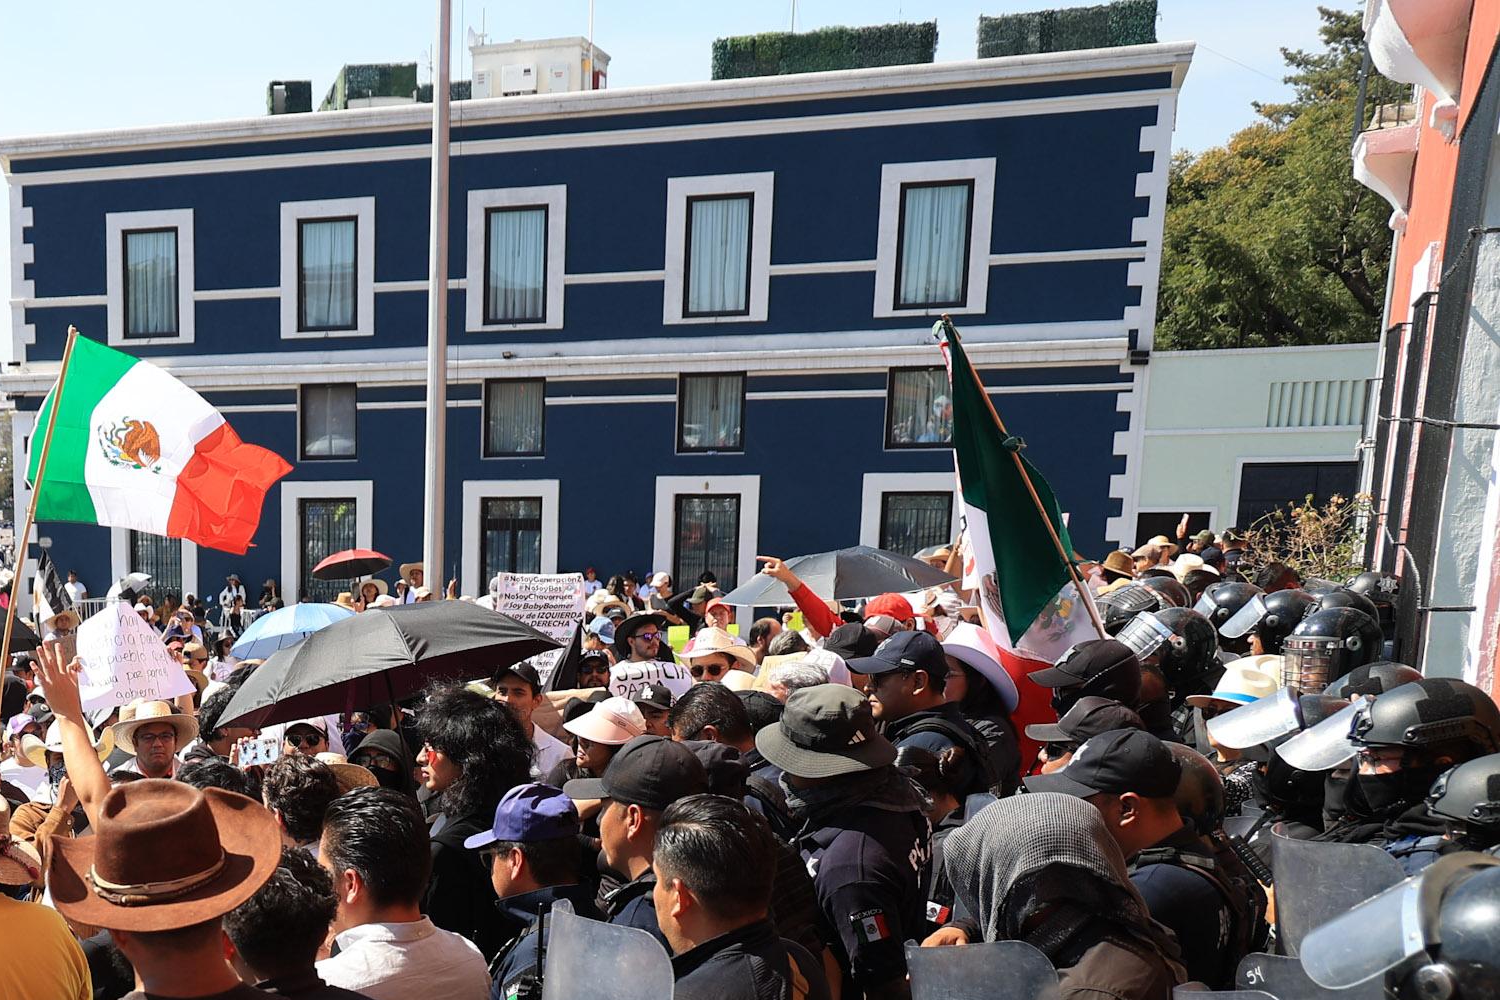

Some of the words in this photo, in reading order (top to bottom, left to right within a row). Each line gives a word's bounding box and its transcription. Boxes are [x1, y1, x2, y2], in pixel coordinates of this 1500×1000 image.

[525, 611, 537, 619] de
[537, 611, 583, 620] IZQUIERDA
[1246, 965, 1265, 985] 54
